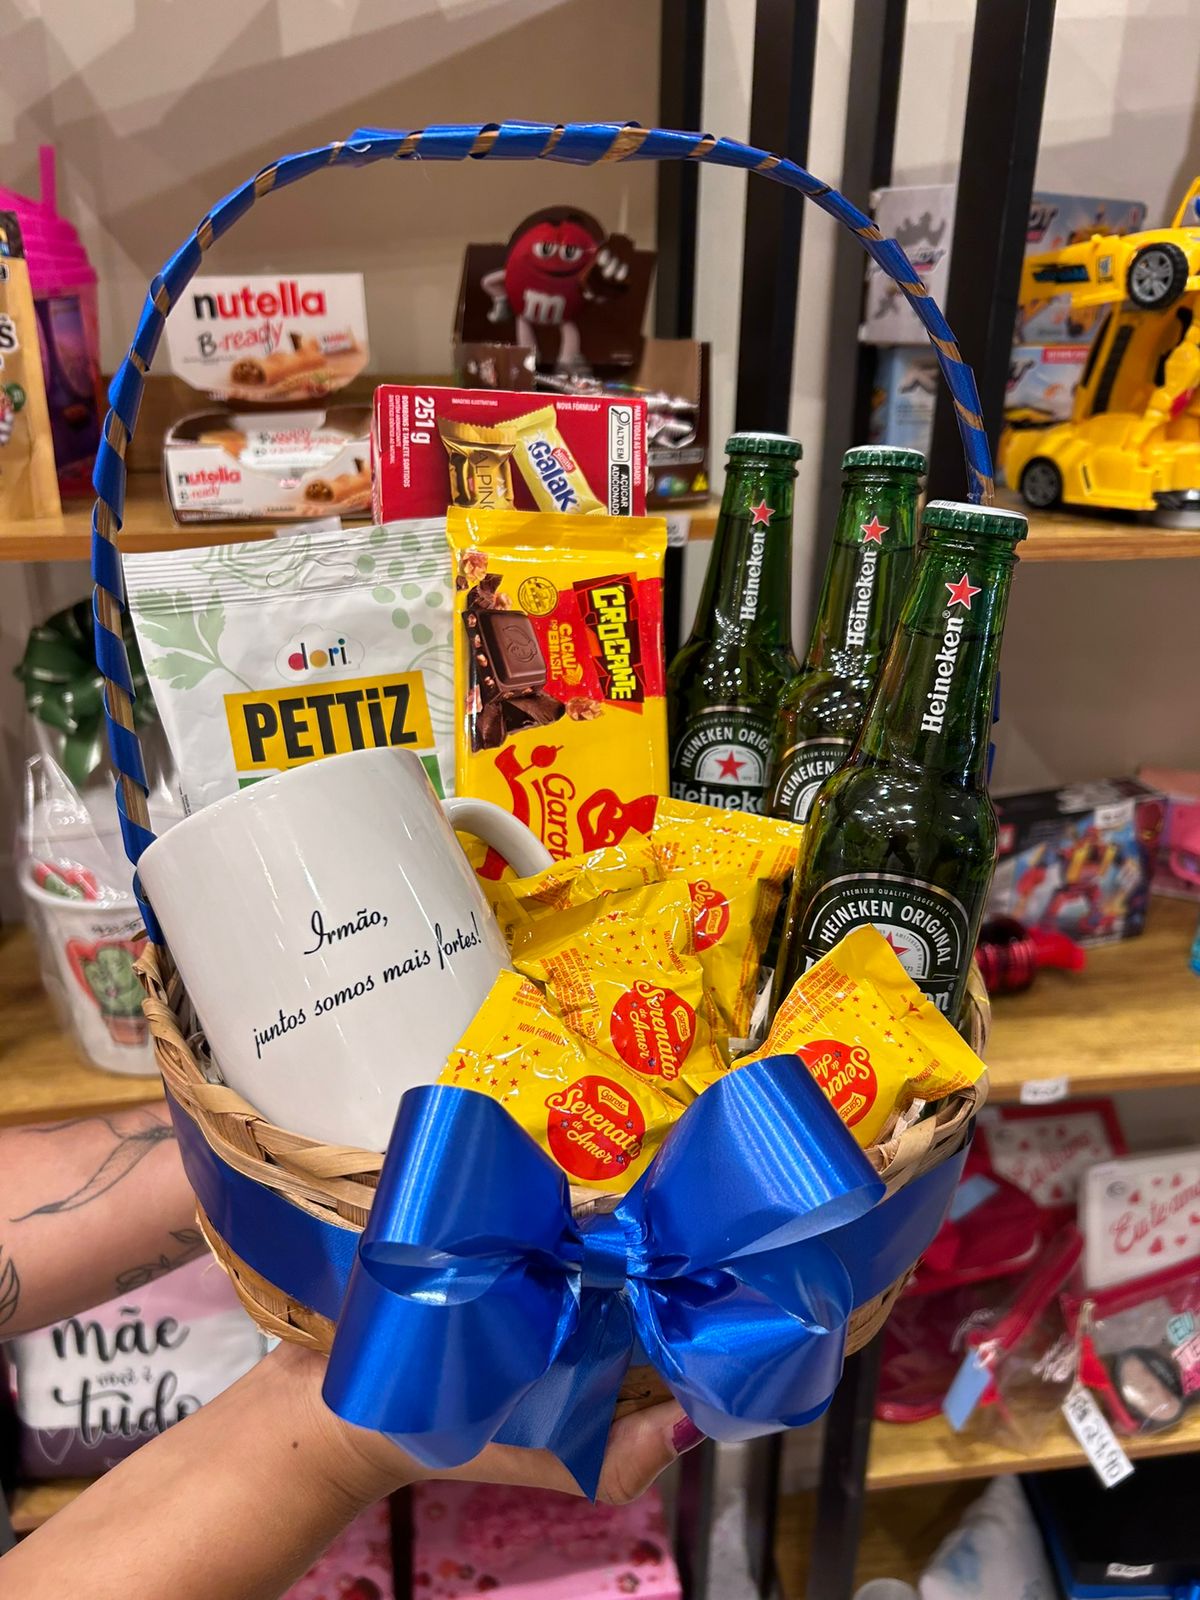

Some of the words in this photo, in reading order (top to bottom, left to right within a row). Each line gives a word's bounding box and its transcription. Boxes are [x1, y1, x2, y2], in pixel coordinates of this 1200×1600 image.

[193, 280, 327, 320] nutella
[415, 396, 435, 427] 251
[556, 402, 571, 411] NOVA
[633, 405, 641, 420] PARA
[402, 432, 410, 457] TABLETE
[410, 432, 431, 444] g
[633, 421, 641, 441] TODAS
[633, 441, 641, 449] AS
[617, 448, 624, 459] EM
[178, 466, 241, 486] nutella
[528, 441, 578, 512] Galak
[611, 466, 619, 515] ADICIONADO
[740, 532, 765, 621] Heineken
[845, 549, 877, 648] Heineken
[288, 638, 352, 671] dori
[548, 631, 563, 680] BRASIL
[559, 623, 577, 669] CACAU
[591, 585, 636, 700] CROCANTE
[920, 616, 965, 734] Heineken
[681, 727, 733, 768] HEINEKEN
[794, 751, 819, 763] PREMIUM
[780, 760, 835, 806] HEINEKEN
[542, 773, 575, 861] Garot
[842, 887, 875, 897] PREMIUM
[878, 888, 911, 899] QUALITY
[913, 895, 934, 907] LAGER
[303, 908, 388, 955] Irmão,
[820, 900, 894, 944] HEINEKEN
[900, 905, 952, 966] ORIGINAL
[253, 1008, 306, 1059] juntos
[314, 975, 375, 1016] somos
[382, 949, 431, 983] mais
[435, 911, 482, 970] fortes!
[517, 1022, 535, 1037] NOVA
[635, 981, 677, 1079] Serenata
[639, 1008, 647, 1019] de
[630, 1010, 650, 1058] Amor
[813, 1053, 833, 1079] Am
[824, 1048, 870, 1099] Seren
[600, 1088, 626, 1111] Garoto
[548, 1088, 639, 1157] Serenata
[572, 1120, 582, 1130] de
[566, 1130, 613, 1164] Amor
[53, 1370, 202, 1445] tudo
